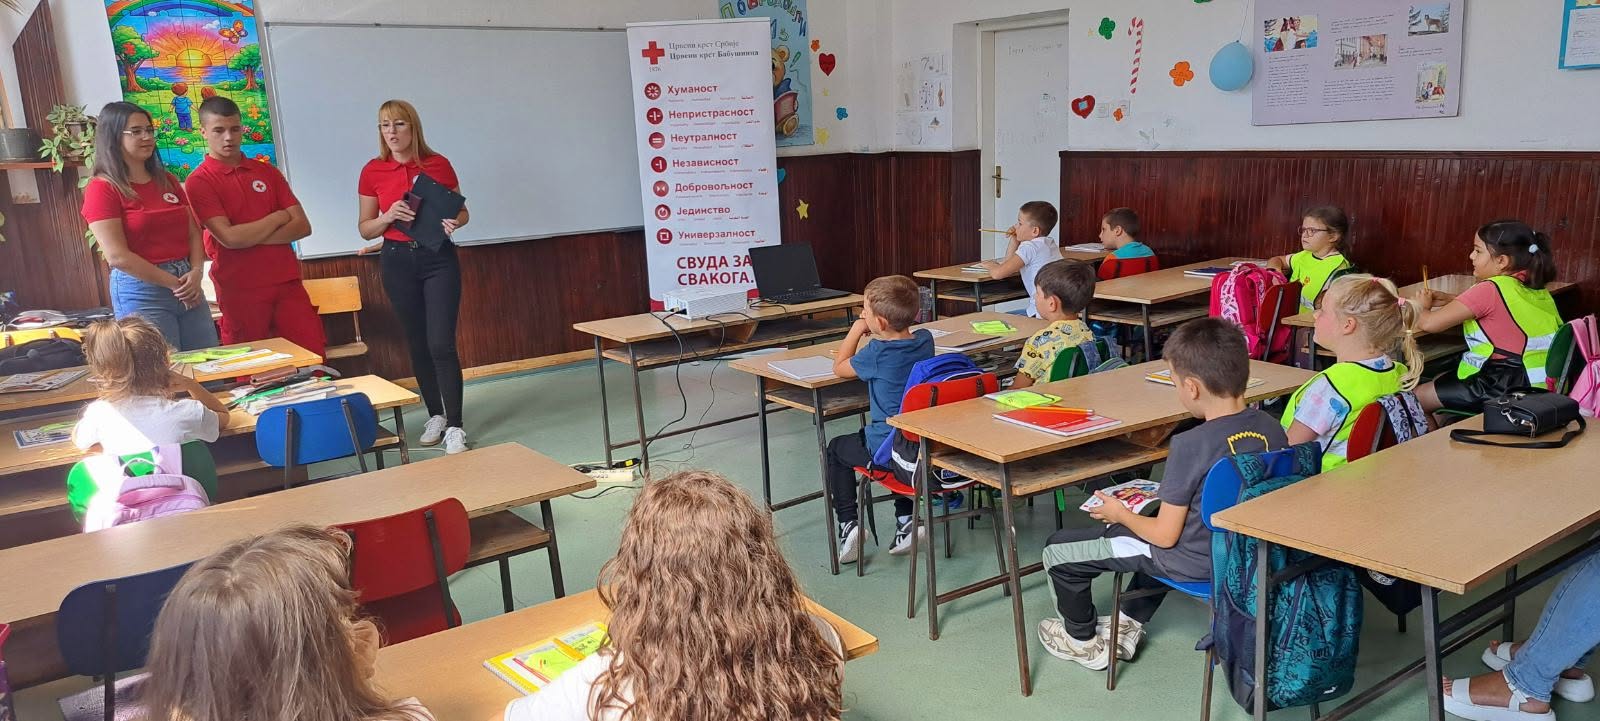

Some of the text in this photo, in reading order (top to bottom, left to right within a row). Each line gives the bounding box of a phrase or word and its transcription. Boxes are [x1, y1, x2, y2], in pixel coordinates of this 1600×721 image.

[667, 85, 718, 96] Хуманост
[669, 108, 755, 120] Непристрасност
[670, 133, 738, 144] Неутралност
[672, 158, 739, 168] Независност
[675, 182, 754, 193] Добровољност
[677, 206, 731, 216] Јединство
[678, 230, 756, 240] Универзалност
[676, 254, 753, 271] СВУДА ЗА
[678, 271, 754, 286] СВАКОГА.
